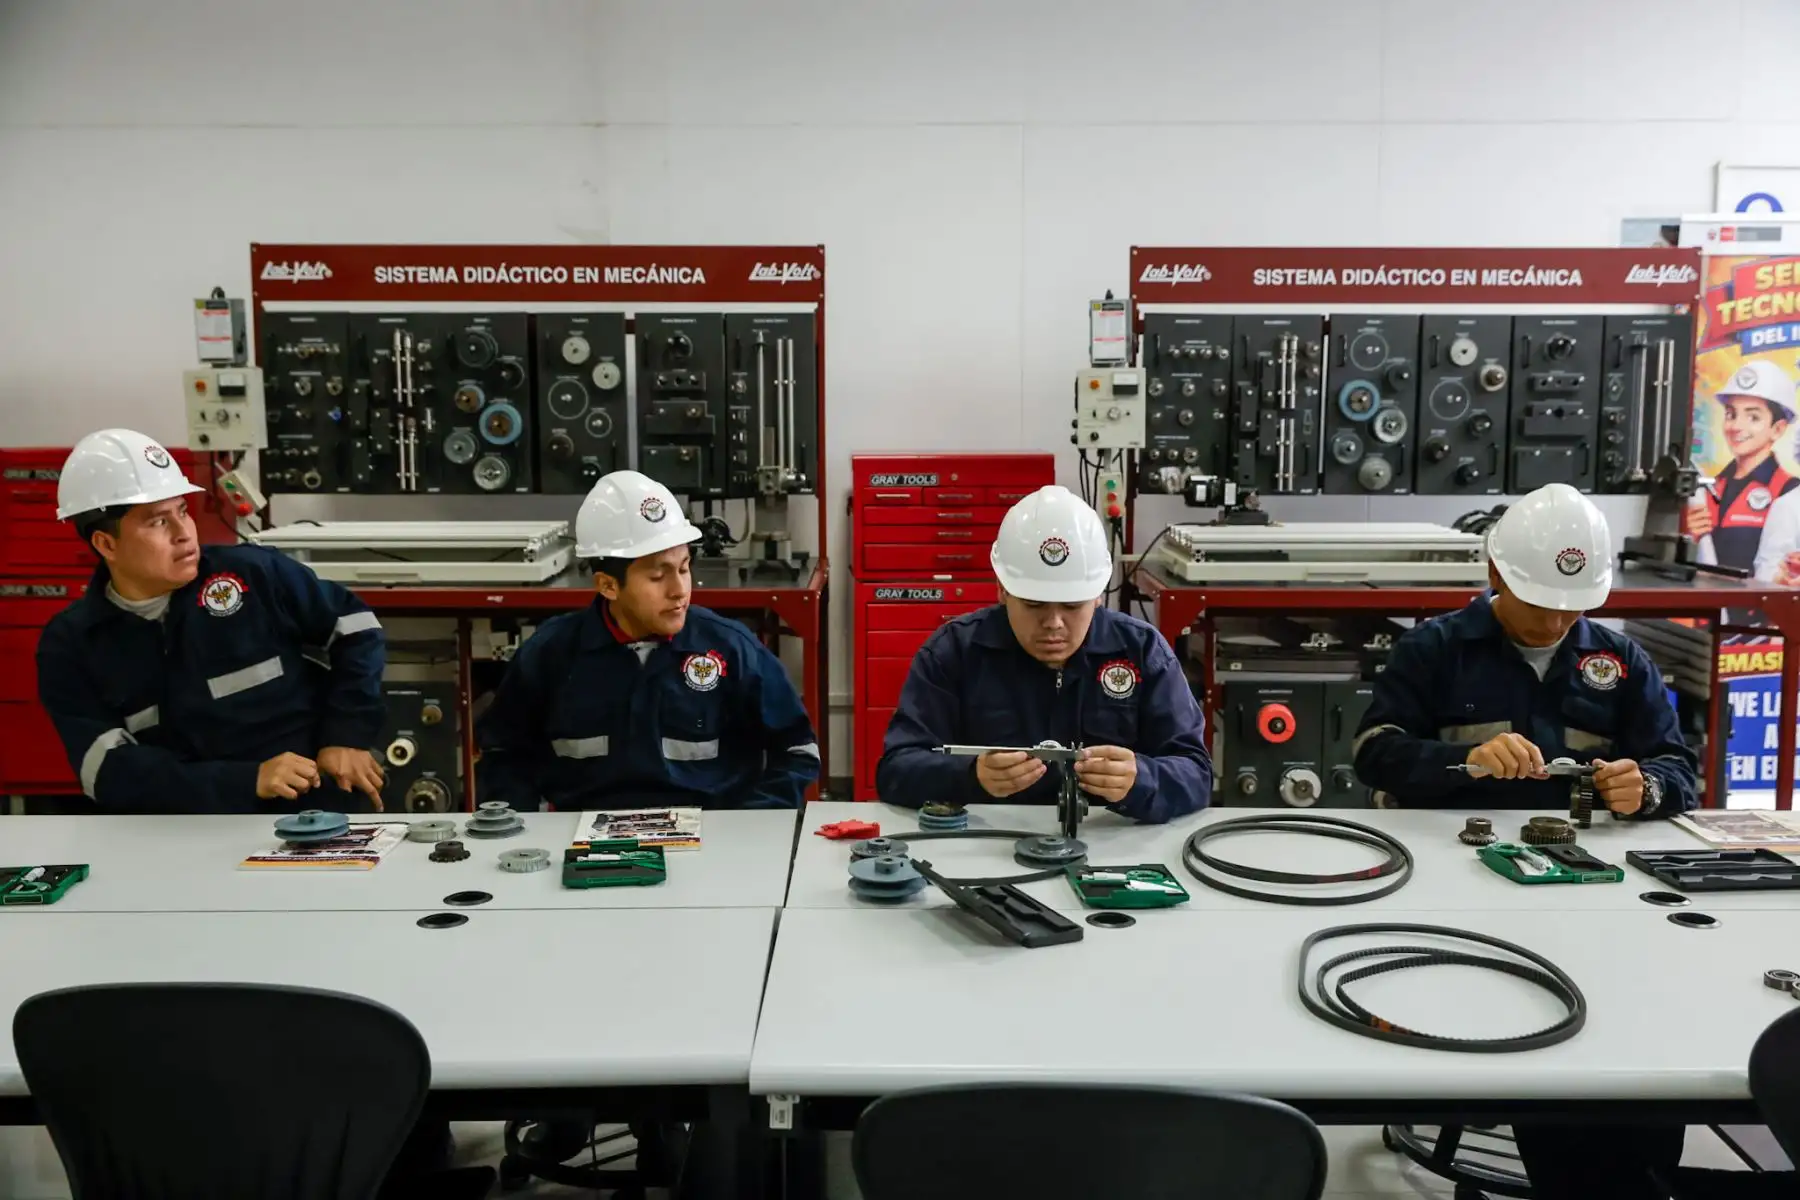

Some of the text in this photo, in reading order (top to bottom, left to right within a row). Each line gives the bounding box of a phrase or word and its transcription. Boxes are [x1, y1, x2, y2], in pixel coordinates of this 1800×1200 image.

[374, 262, 706, 284] SISTEMA DIDÁCTICO EN MECÁNICA
[1253, 264, 1583, 286] SISTEMA DIDÁCTICO EN MECÁNICA
[1751, 326, 1788, 347] DEL
[871, 475, 937, 485] GRAY TOOLS
[875, 588, 943, 599] GRAY TOOLS
